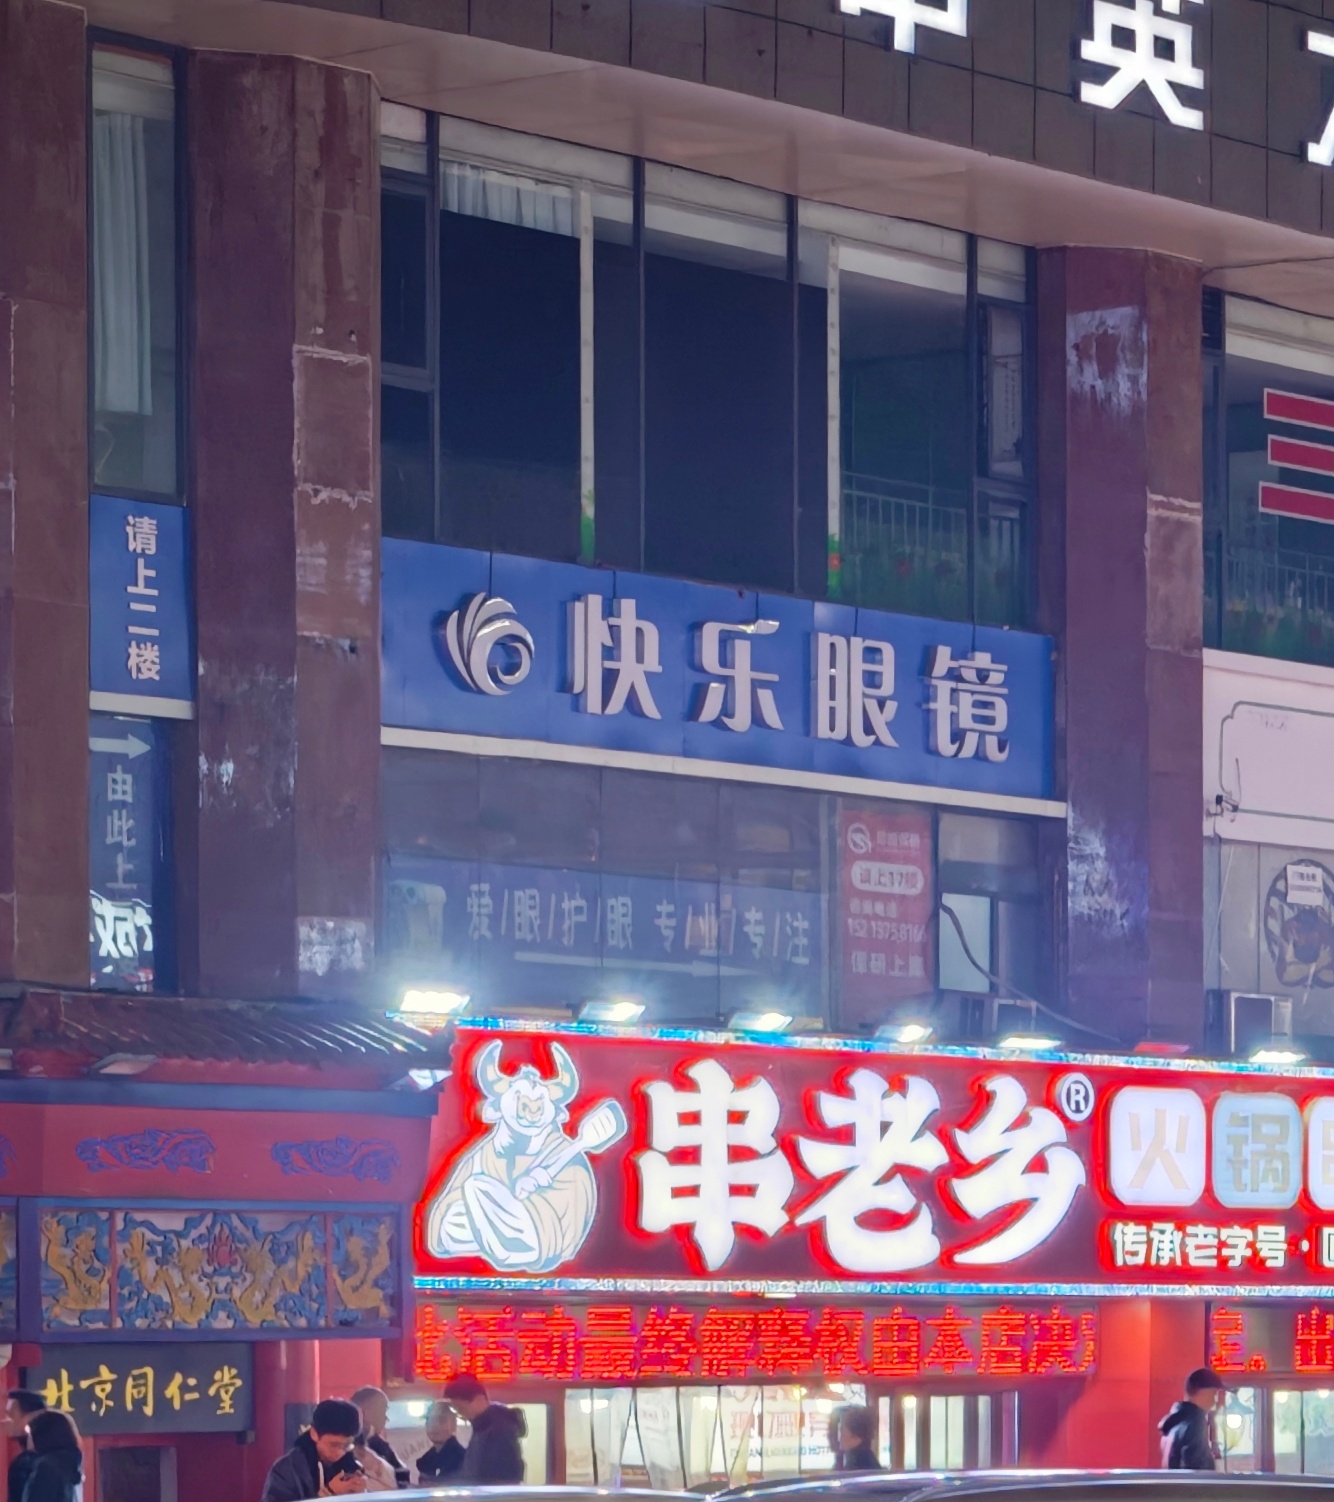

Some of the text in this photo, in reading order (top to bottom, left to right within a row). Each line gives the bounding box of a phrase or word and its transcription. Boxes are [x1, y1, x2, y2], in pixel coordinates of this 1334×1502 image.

[125, 514, 161, 682] 请上二楼
[570, 594, 1011, 763] 快乐眼镜
[636, 1056, 1087, 1274] 串老乡
[38, 1363, 243, 1416] 北京同仁堂
